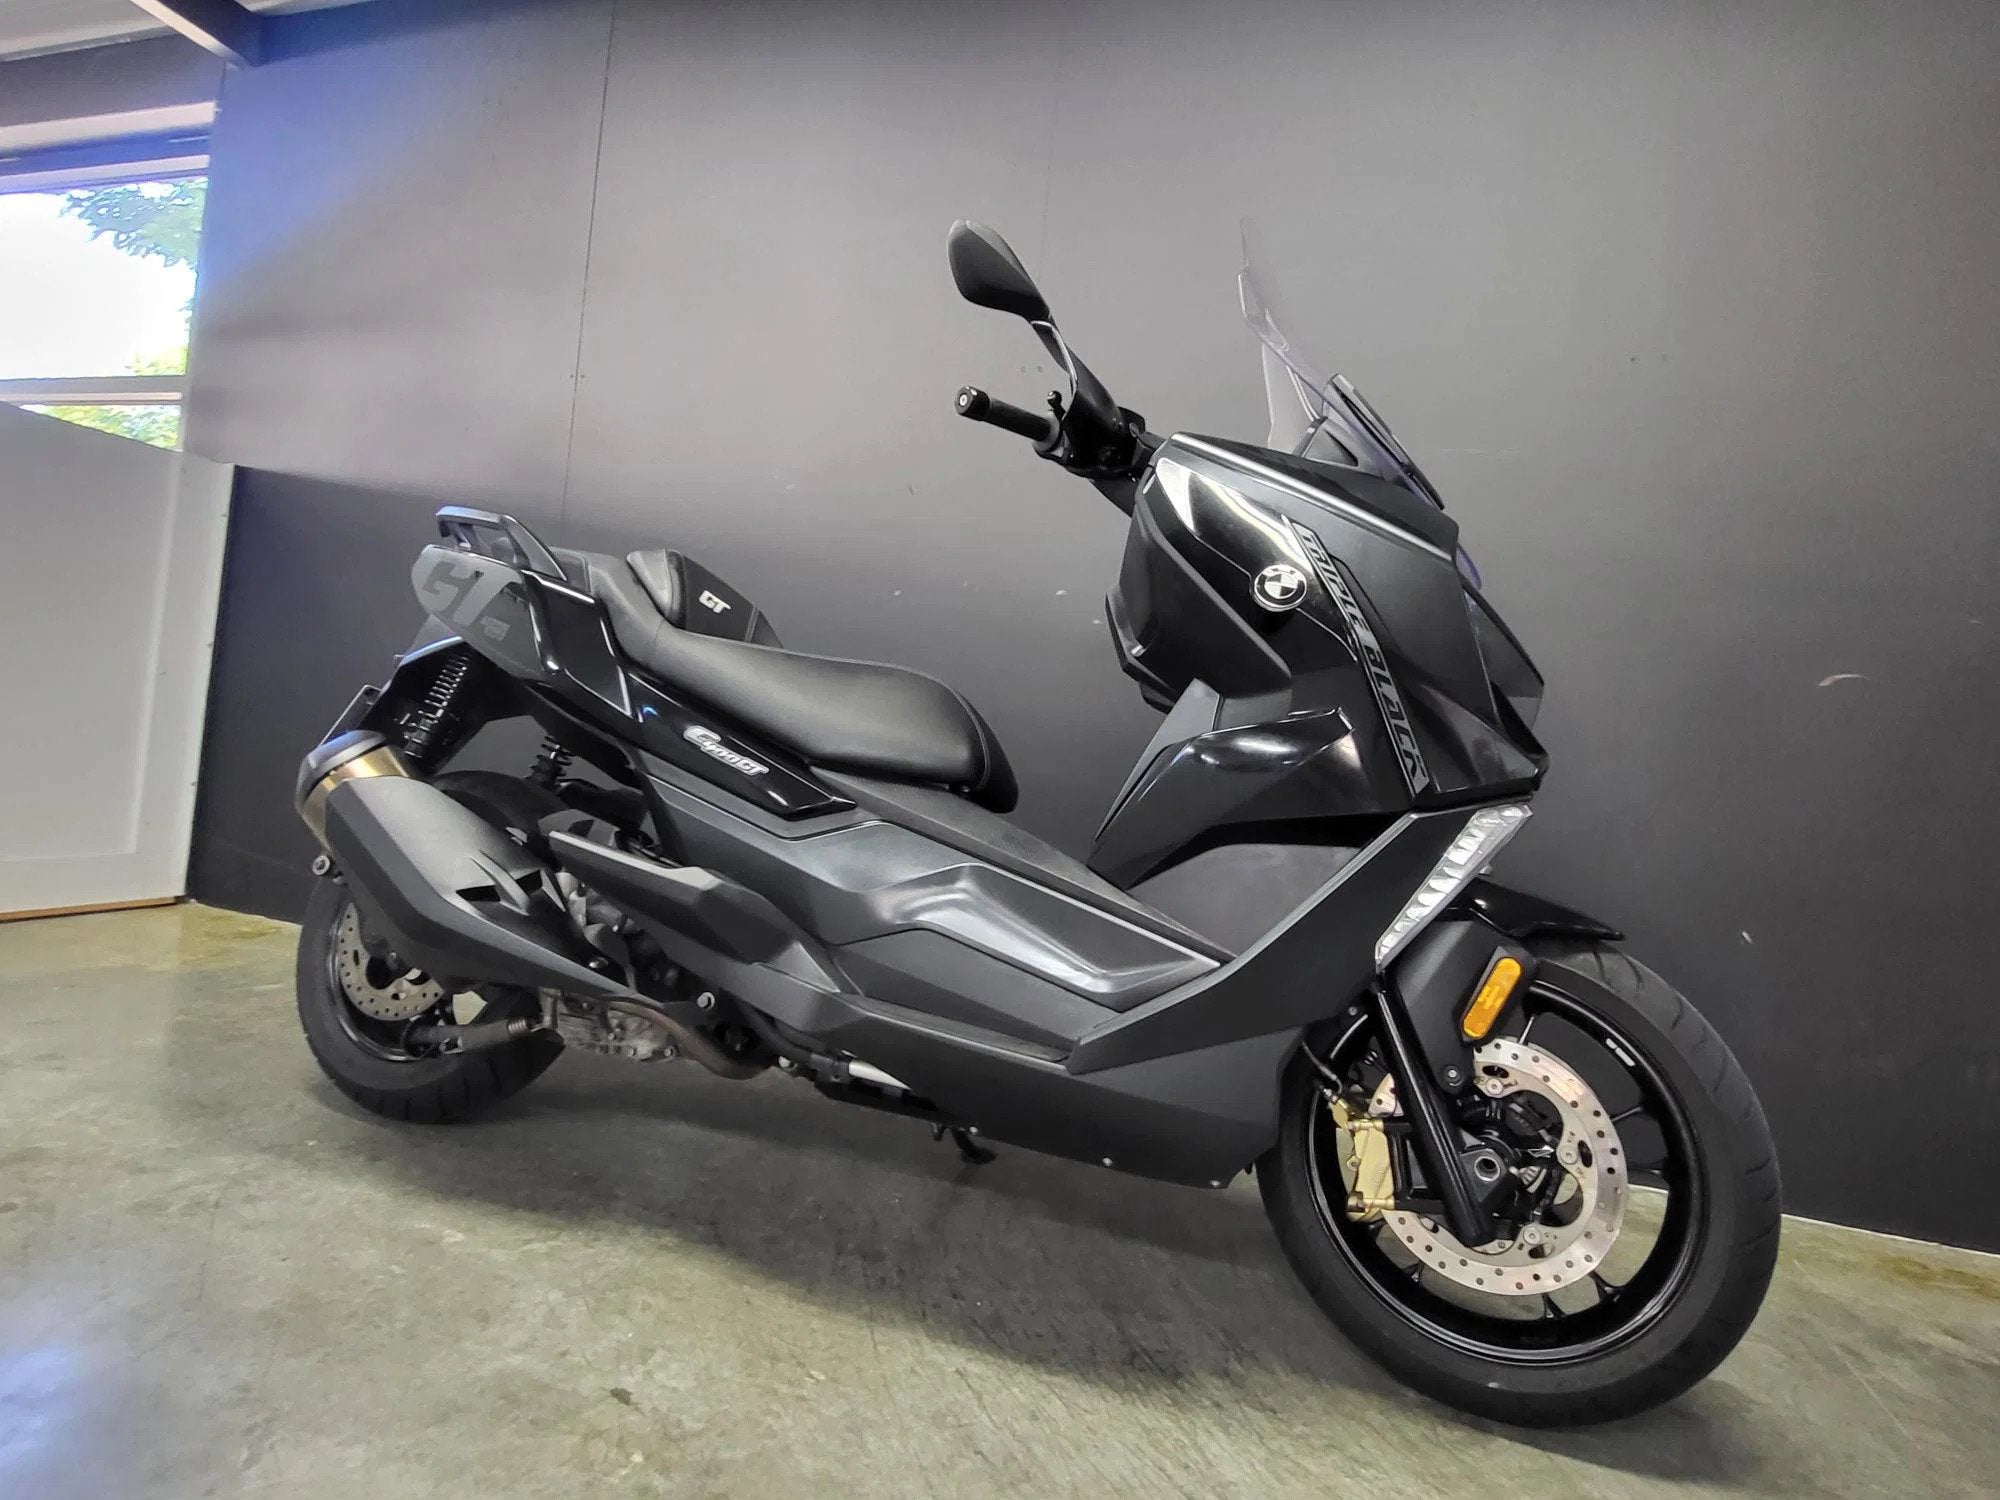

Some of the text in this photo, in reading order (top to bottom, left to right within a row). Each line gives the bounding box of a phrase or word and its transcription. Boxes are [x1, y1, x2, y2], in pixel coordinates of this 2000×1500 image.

[699, 590, 731, 613] GT
[1301, 533, 1428, 779] TRIPLE BLACK
